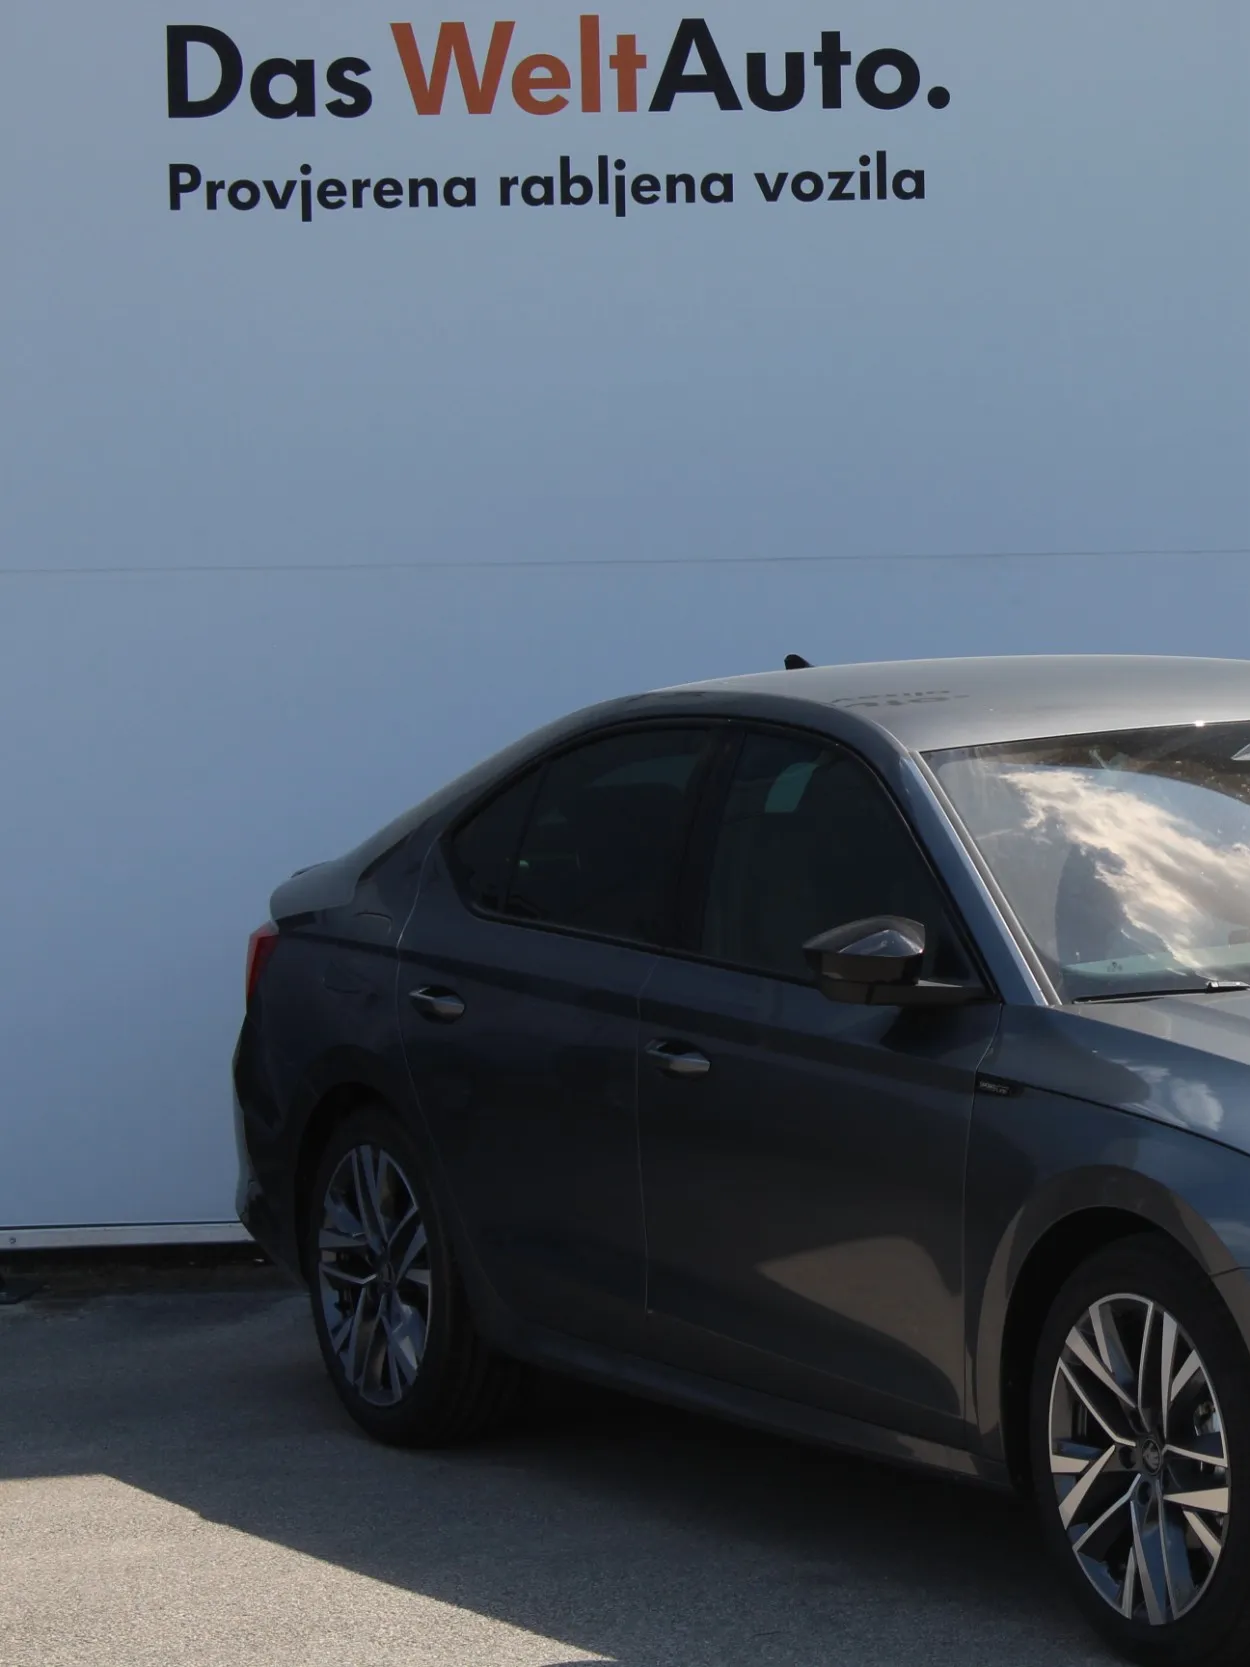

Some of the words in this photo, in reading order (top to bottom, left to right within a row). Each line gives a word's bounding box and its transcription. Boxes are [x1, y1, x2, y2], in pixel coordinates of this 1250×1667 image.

[167, 25, 373, 119] Das
[390, 14, 951, 116] WeltAuto.
[168, 163, 476, 223] Provjerena
[499, 154, 734, 218] rabljena
[753, 150, 926, 203] vozila
